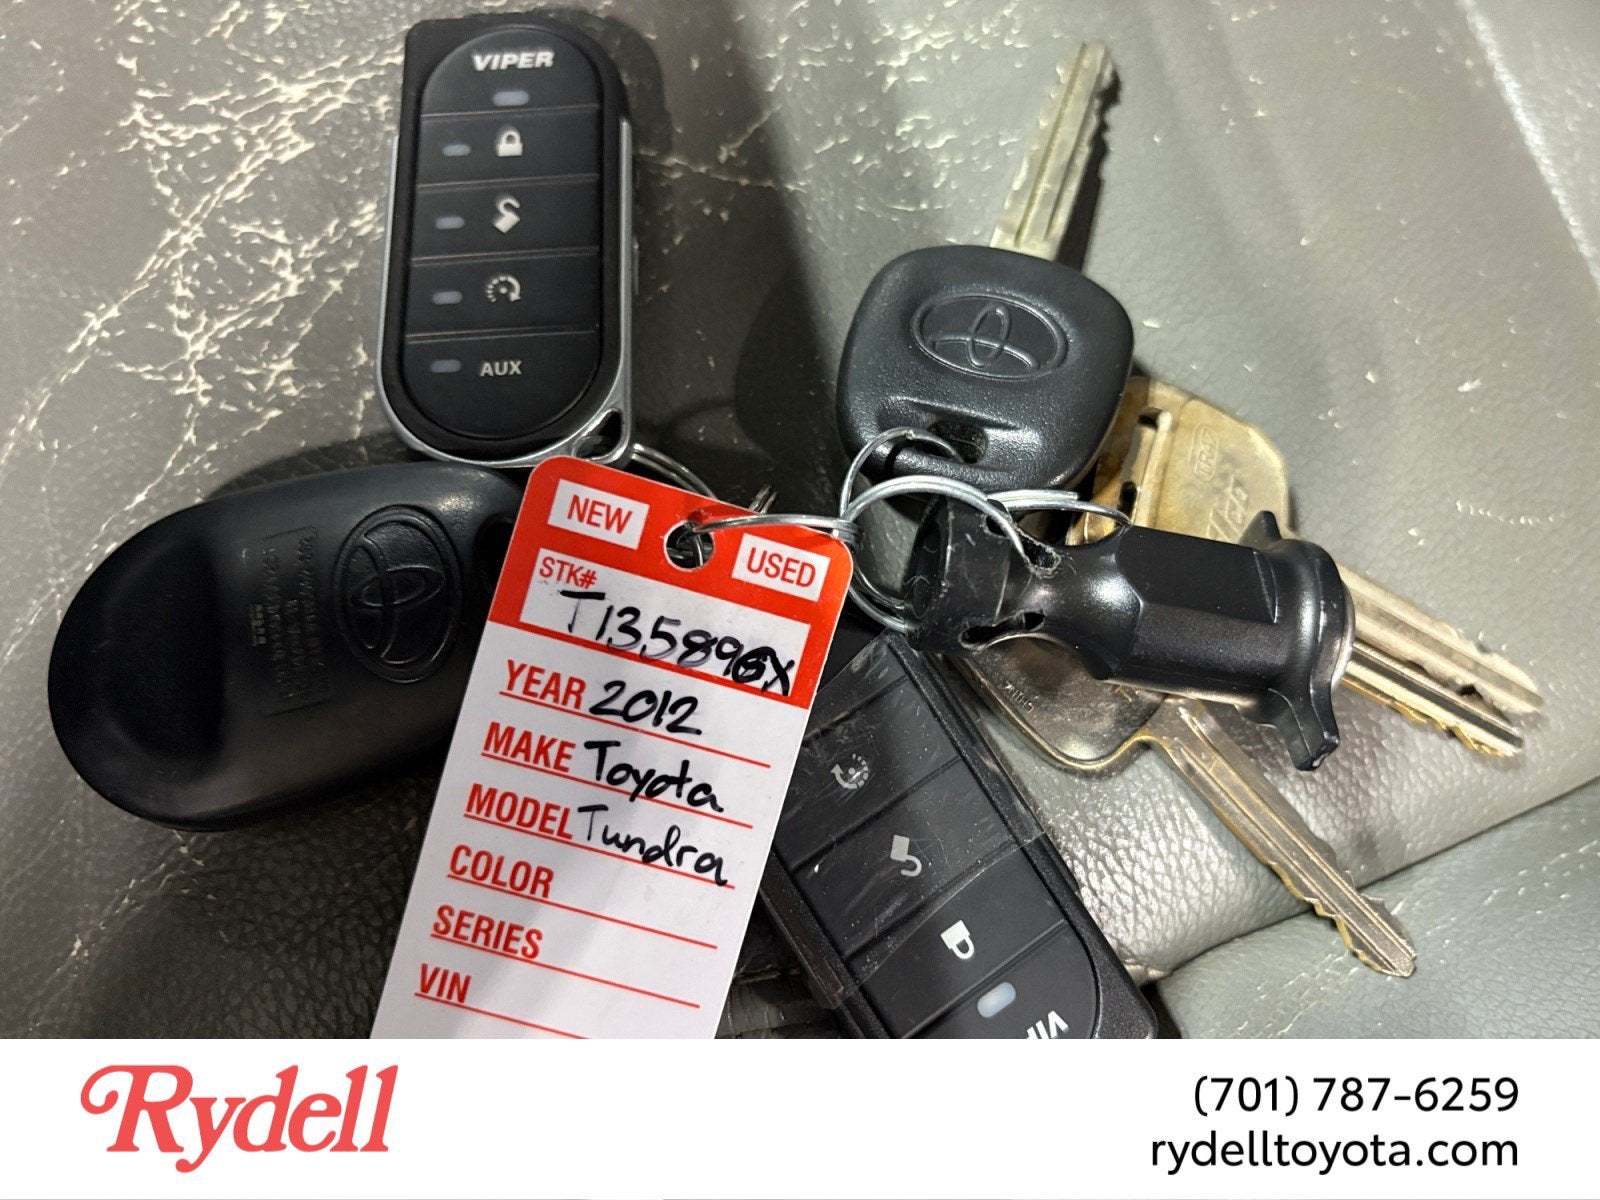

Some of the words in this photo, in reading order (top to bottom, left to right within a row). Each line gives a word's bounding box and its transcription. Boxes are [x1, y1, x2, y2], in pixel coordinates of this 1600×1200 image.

[473, 50, 555, 71] VIPER
[480, 360, 522, 378] AUX
[567, 494, 633, 534] NEW
[539, 556, 597, 590] STK#
[747, 547, 817, 588] USED
[505, 660, 587, 710] YEAR
[589, 680, 703, 736] 2012
[483, 721, 576, 773] MAKE
[584, 741, 724, 813] Toyota
[466, 783, 574, 840] MODEL
[578, 805, 729, 887] Tundra
[449, 844, 555, 899] COLOR
[433, 904, 544, 959] SERIES
[419, 962, 471, 1003] VIN
